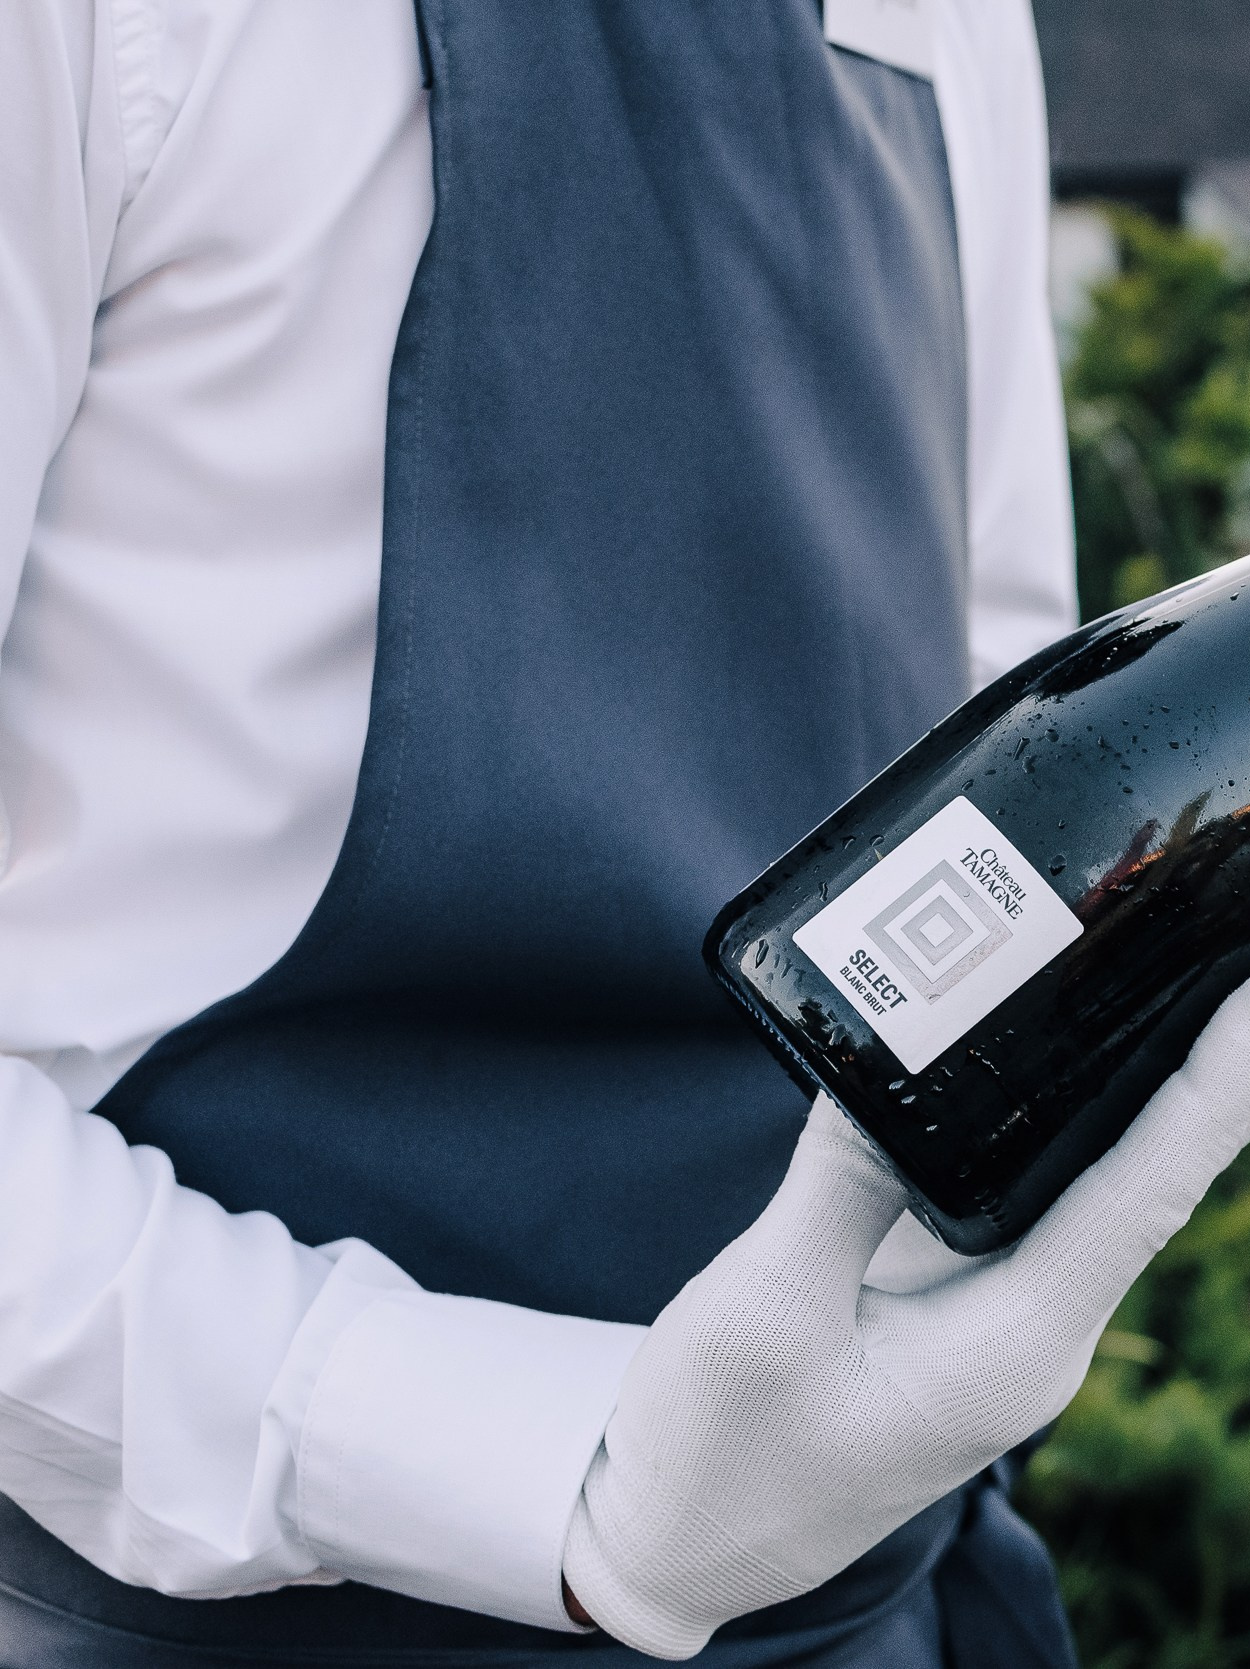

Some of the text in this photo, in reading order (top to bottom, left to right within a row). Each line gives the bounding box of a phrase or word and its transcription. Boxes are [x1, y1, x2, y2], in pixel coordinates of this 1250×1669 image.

[960, 848, 1023, 919] TAMAGNE
[980, 848, 1026, 901] Château
[840, 966, 887, 1016] BLANC BRUT
[849, 949, 908, 1009] SELECT
